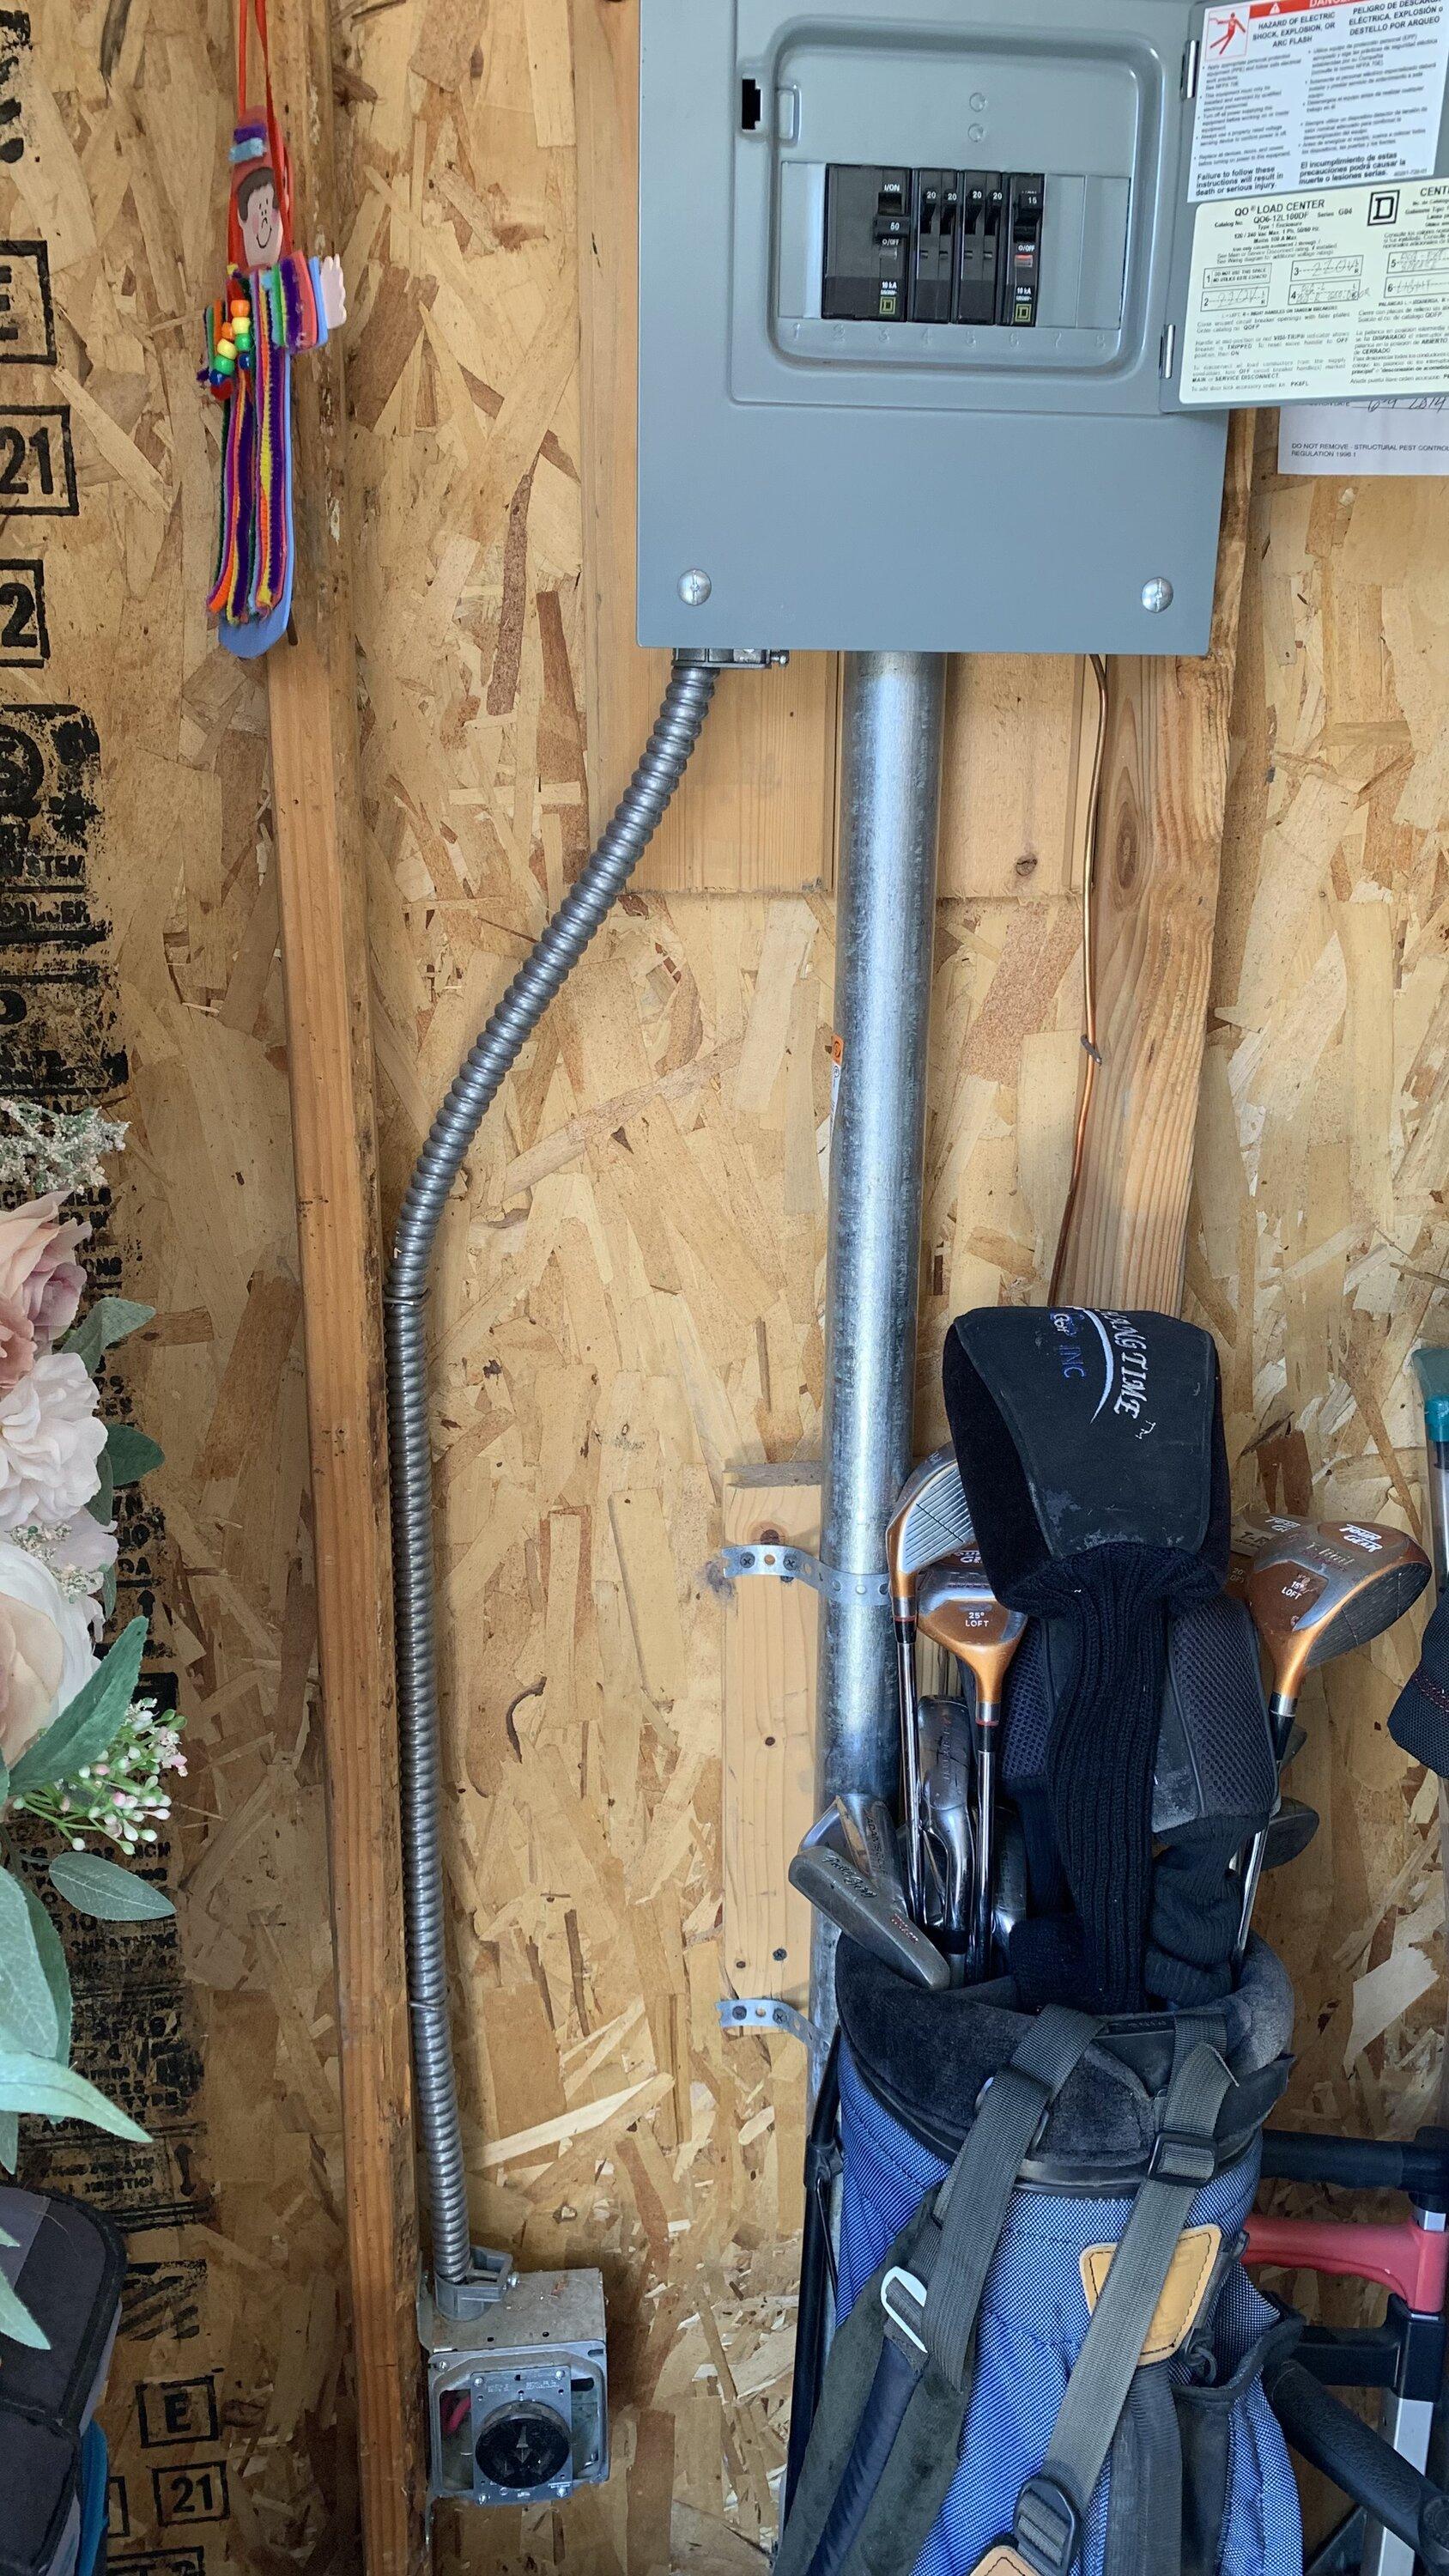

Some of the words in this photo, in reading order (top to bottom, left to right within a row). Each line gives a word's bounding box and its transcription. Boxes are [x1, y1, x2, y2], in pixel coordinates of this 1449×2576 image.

[1353, 3, 1385, 15] PELIGRO
[1387, 1, 1397, 9] DE
[1394, 7, 1436, 19] EXPLOSIÓN
[1258, 18, 1287, 29] HAZARD
[1300, 12, 1335, 23] ELECTRIC
[1350, 23, 1388, 36] DESTELLO
[1408, 15, 1440, 27] ARQUEO
[1252, 31, 1278, 40] SHOCK,
[1281, 25, 1322, 36] EXPLOSION,
[1289, 36, 1313, 46] FLASH
[1310, 155, 1365, 168] incumplimiento
[1378, 152, 1397, 161] estas
[1232, 168, 1254, 177] follow
[1300, 166, 1347, 178] precauciones
[1373, 160, 1397, 169] causar
[1197, 179, 1238, 188] instructions
[1299, 176, 1324, 185] muerte
[1332, 172, 1361, 181] lesiones
[948, 192, 957, 201] 20
[973, 191, 982, 199] 20
[993, 191, 1003, 201] 20
[1196, 188, 1215, 197] death
[1227, 185, 1252, 193] serious
[1257, 204, 1283, 215] LOAD
[1288, 199, 1325, 211] CENTER
[1391, 259, 1397, 268] 5
[1207, 275, 1210, 283] 1
[1387, 283, 1393, 292] 6
[1203, 298, 1209, 307] 2
[1058, 1345, 1085, 1378] INC
[1113, 1352, 1149, 1419] TIME
[1282, 1587, 1302, 1601] LOFT
[166, 2393, 191, 2433] E
[172, 2473, 213, 2512] 21
